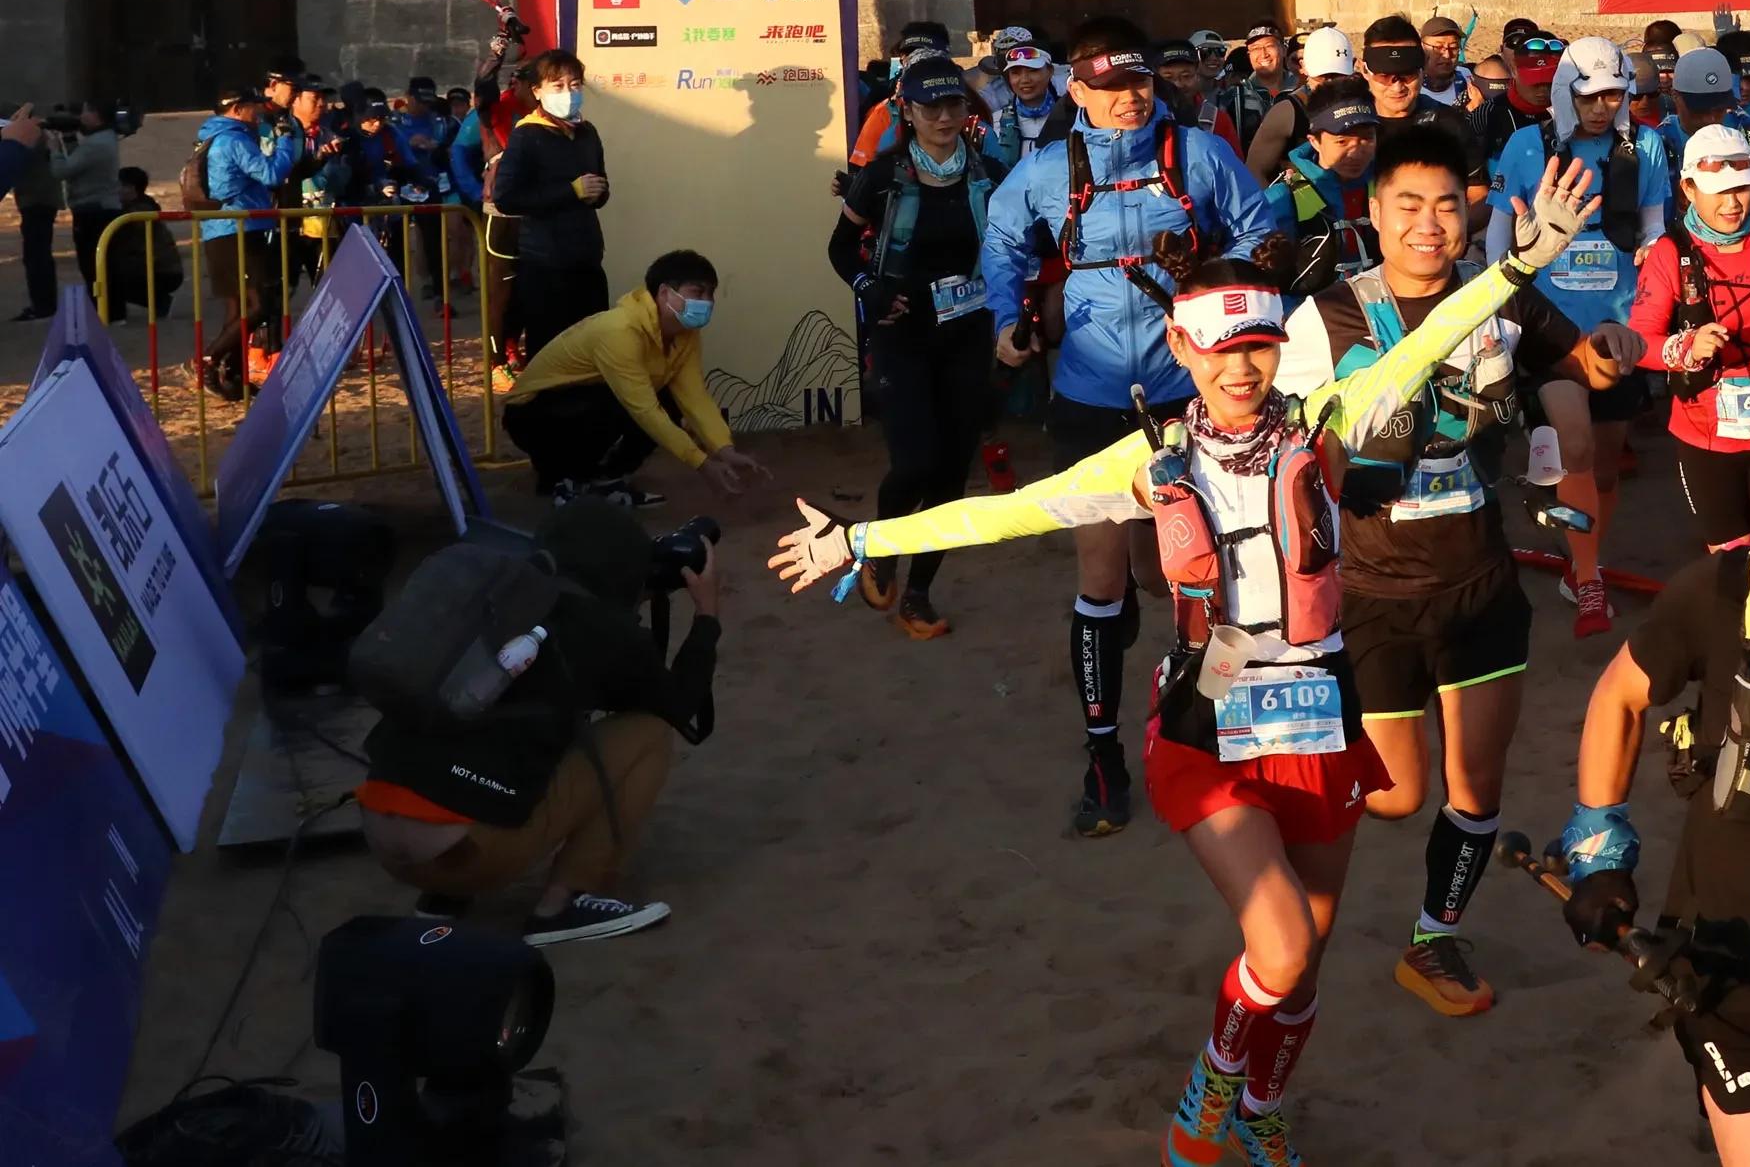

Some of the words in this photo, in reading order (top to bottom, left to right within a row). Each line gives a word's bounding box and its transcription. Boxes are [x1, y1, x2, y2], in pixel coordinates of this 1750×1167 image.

[762, 24, 827, 39] 来跑吧
[1261, 684, 1331, 711] 6109
[450, 764, 471, 779] NOT
[470, 774, 477, 783] A
